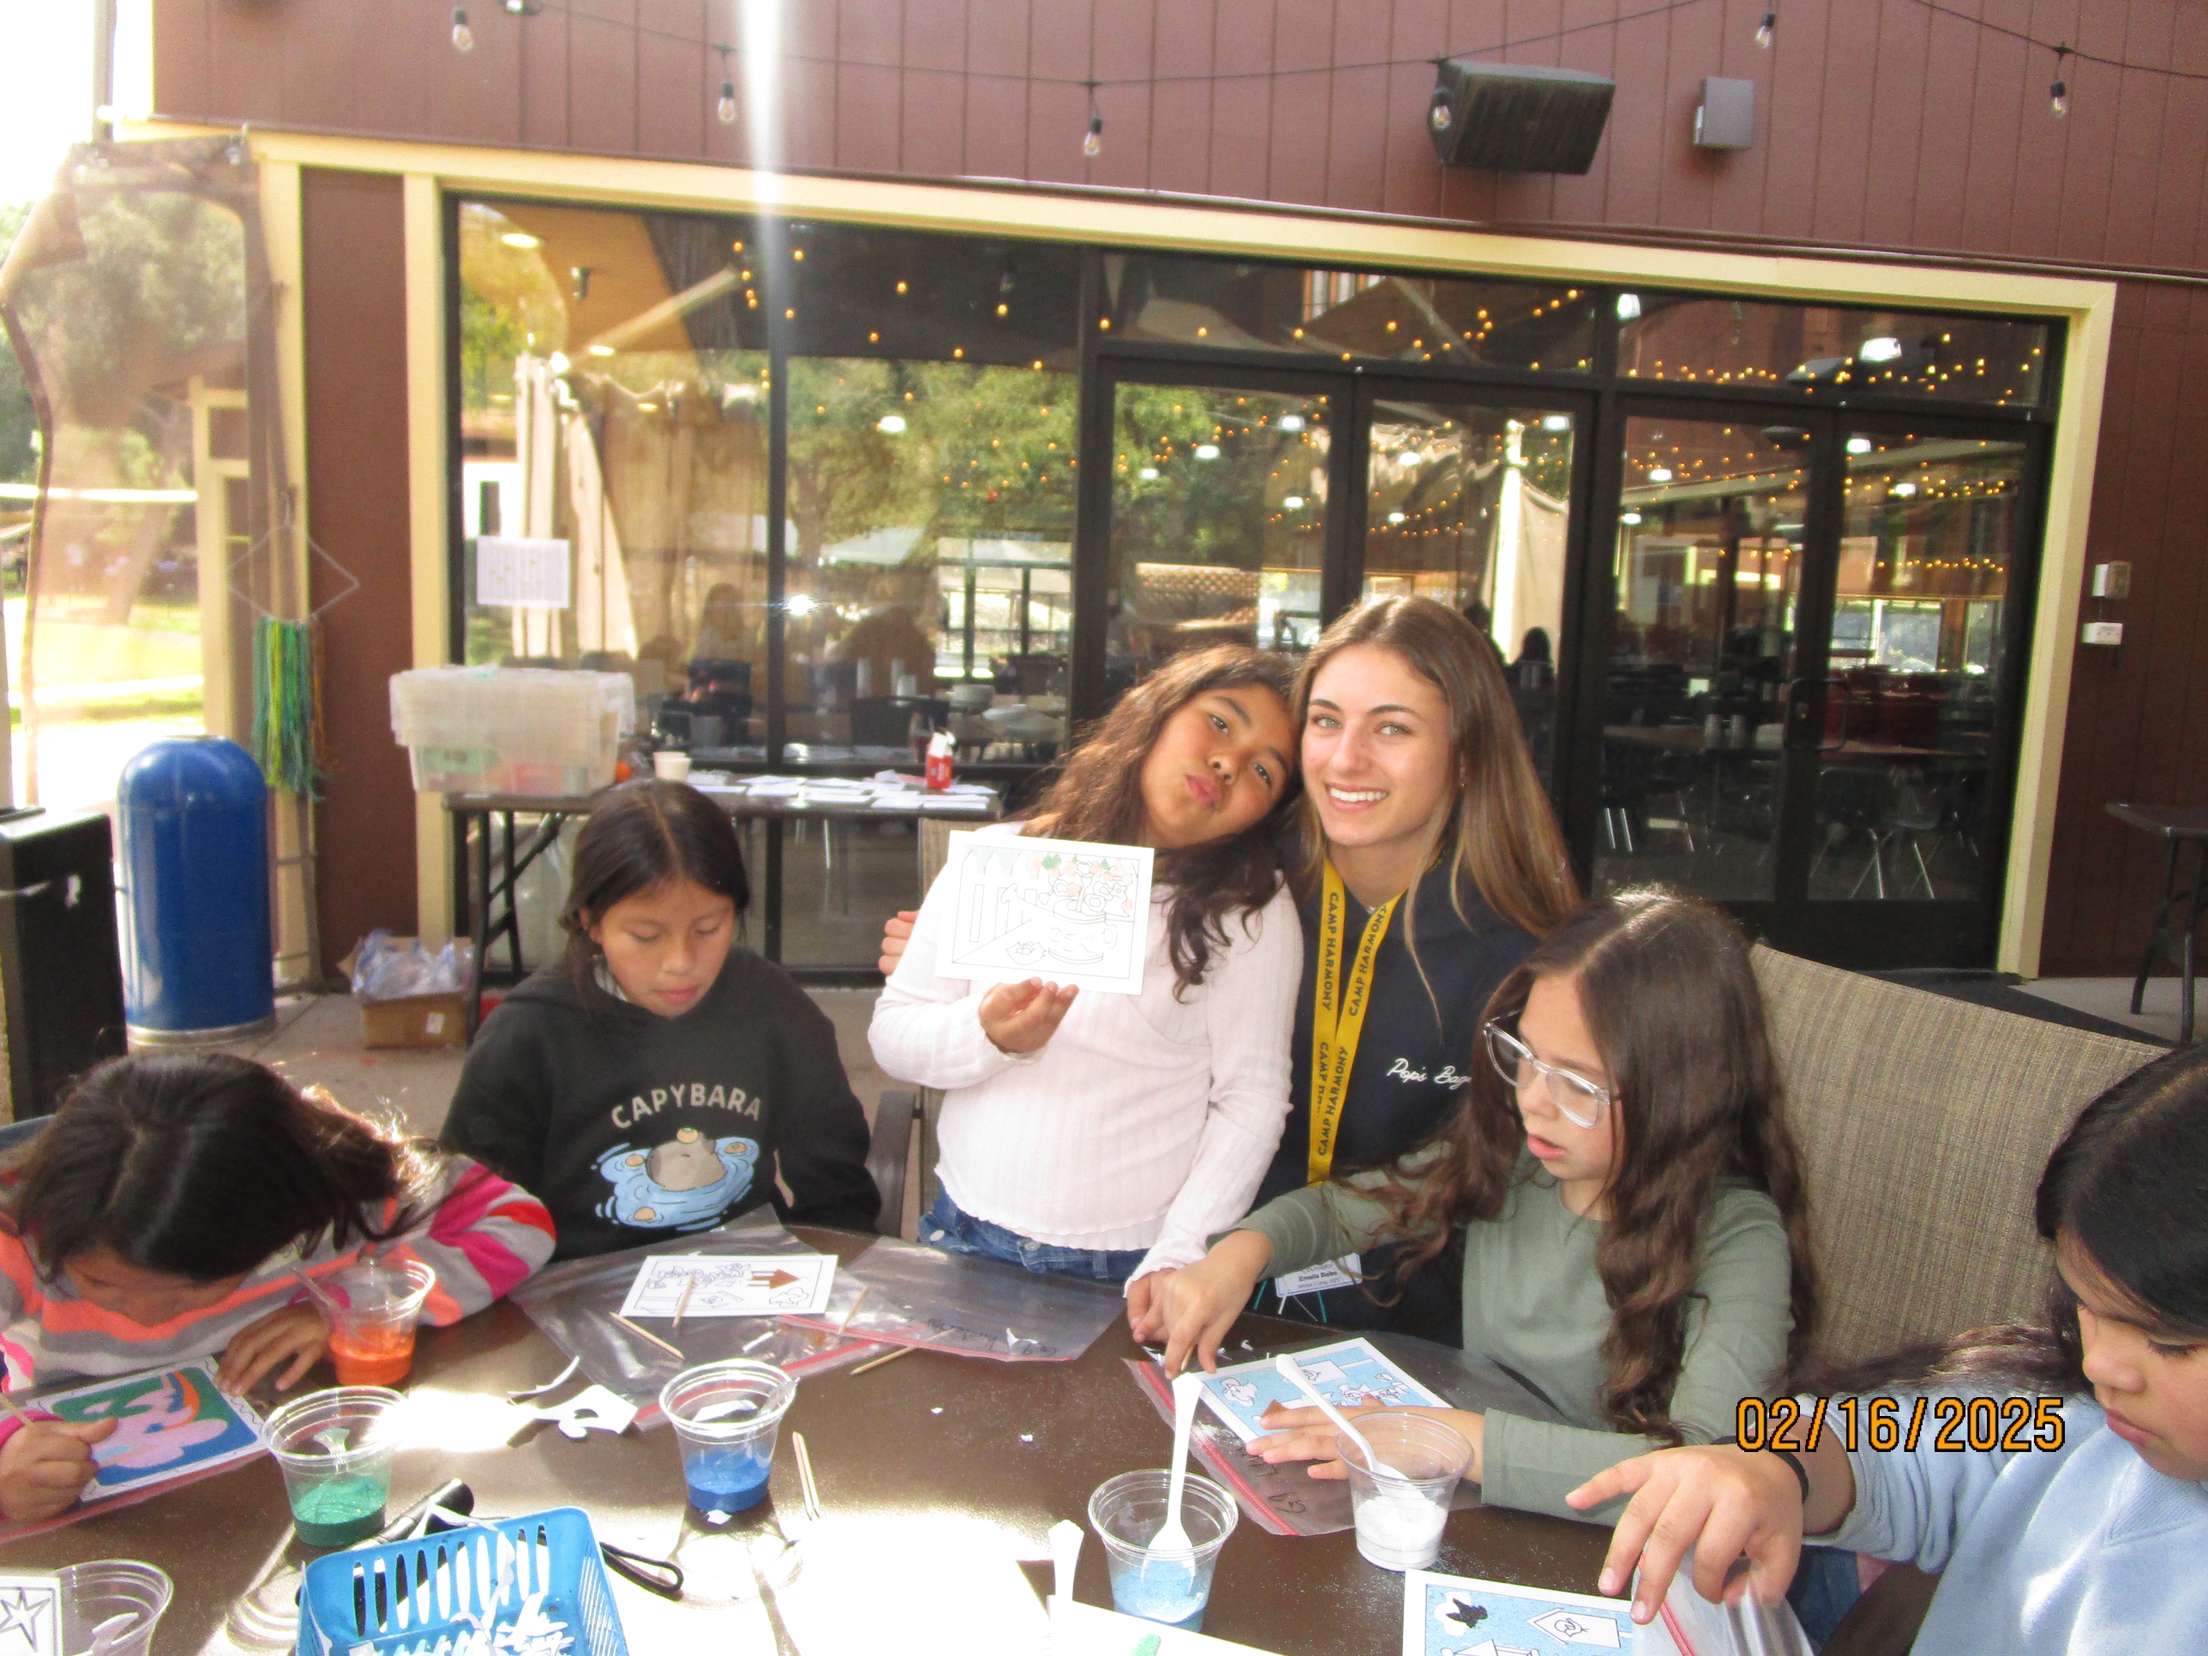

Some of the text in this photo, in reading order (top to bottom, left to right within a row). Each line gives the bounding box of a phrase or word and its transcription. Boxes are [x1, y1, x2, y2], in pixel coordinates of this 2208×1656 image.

[1322, 892, 1339, 1011] CAMP HARMONY
[1348, 905, 1387, 1016] CAMP HARMONY
[611, 1083, 761, 1129] CAPYBARA
[1318, 1042, 1329, 1082] CAMP
[1318, 1118, 1332, 1156] CAMP
[1326, 1046, 1349, 1115] HARMONY
